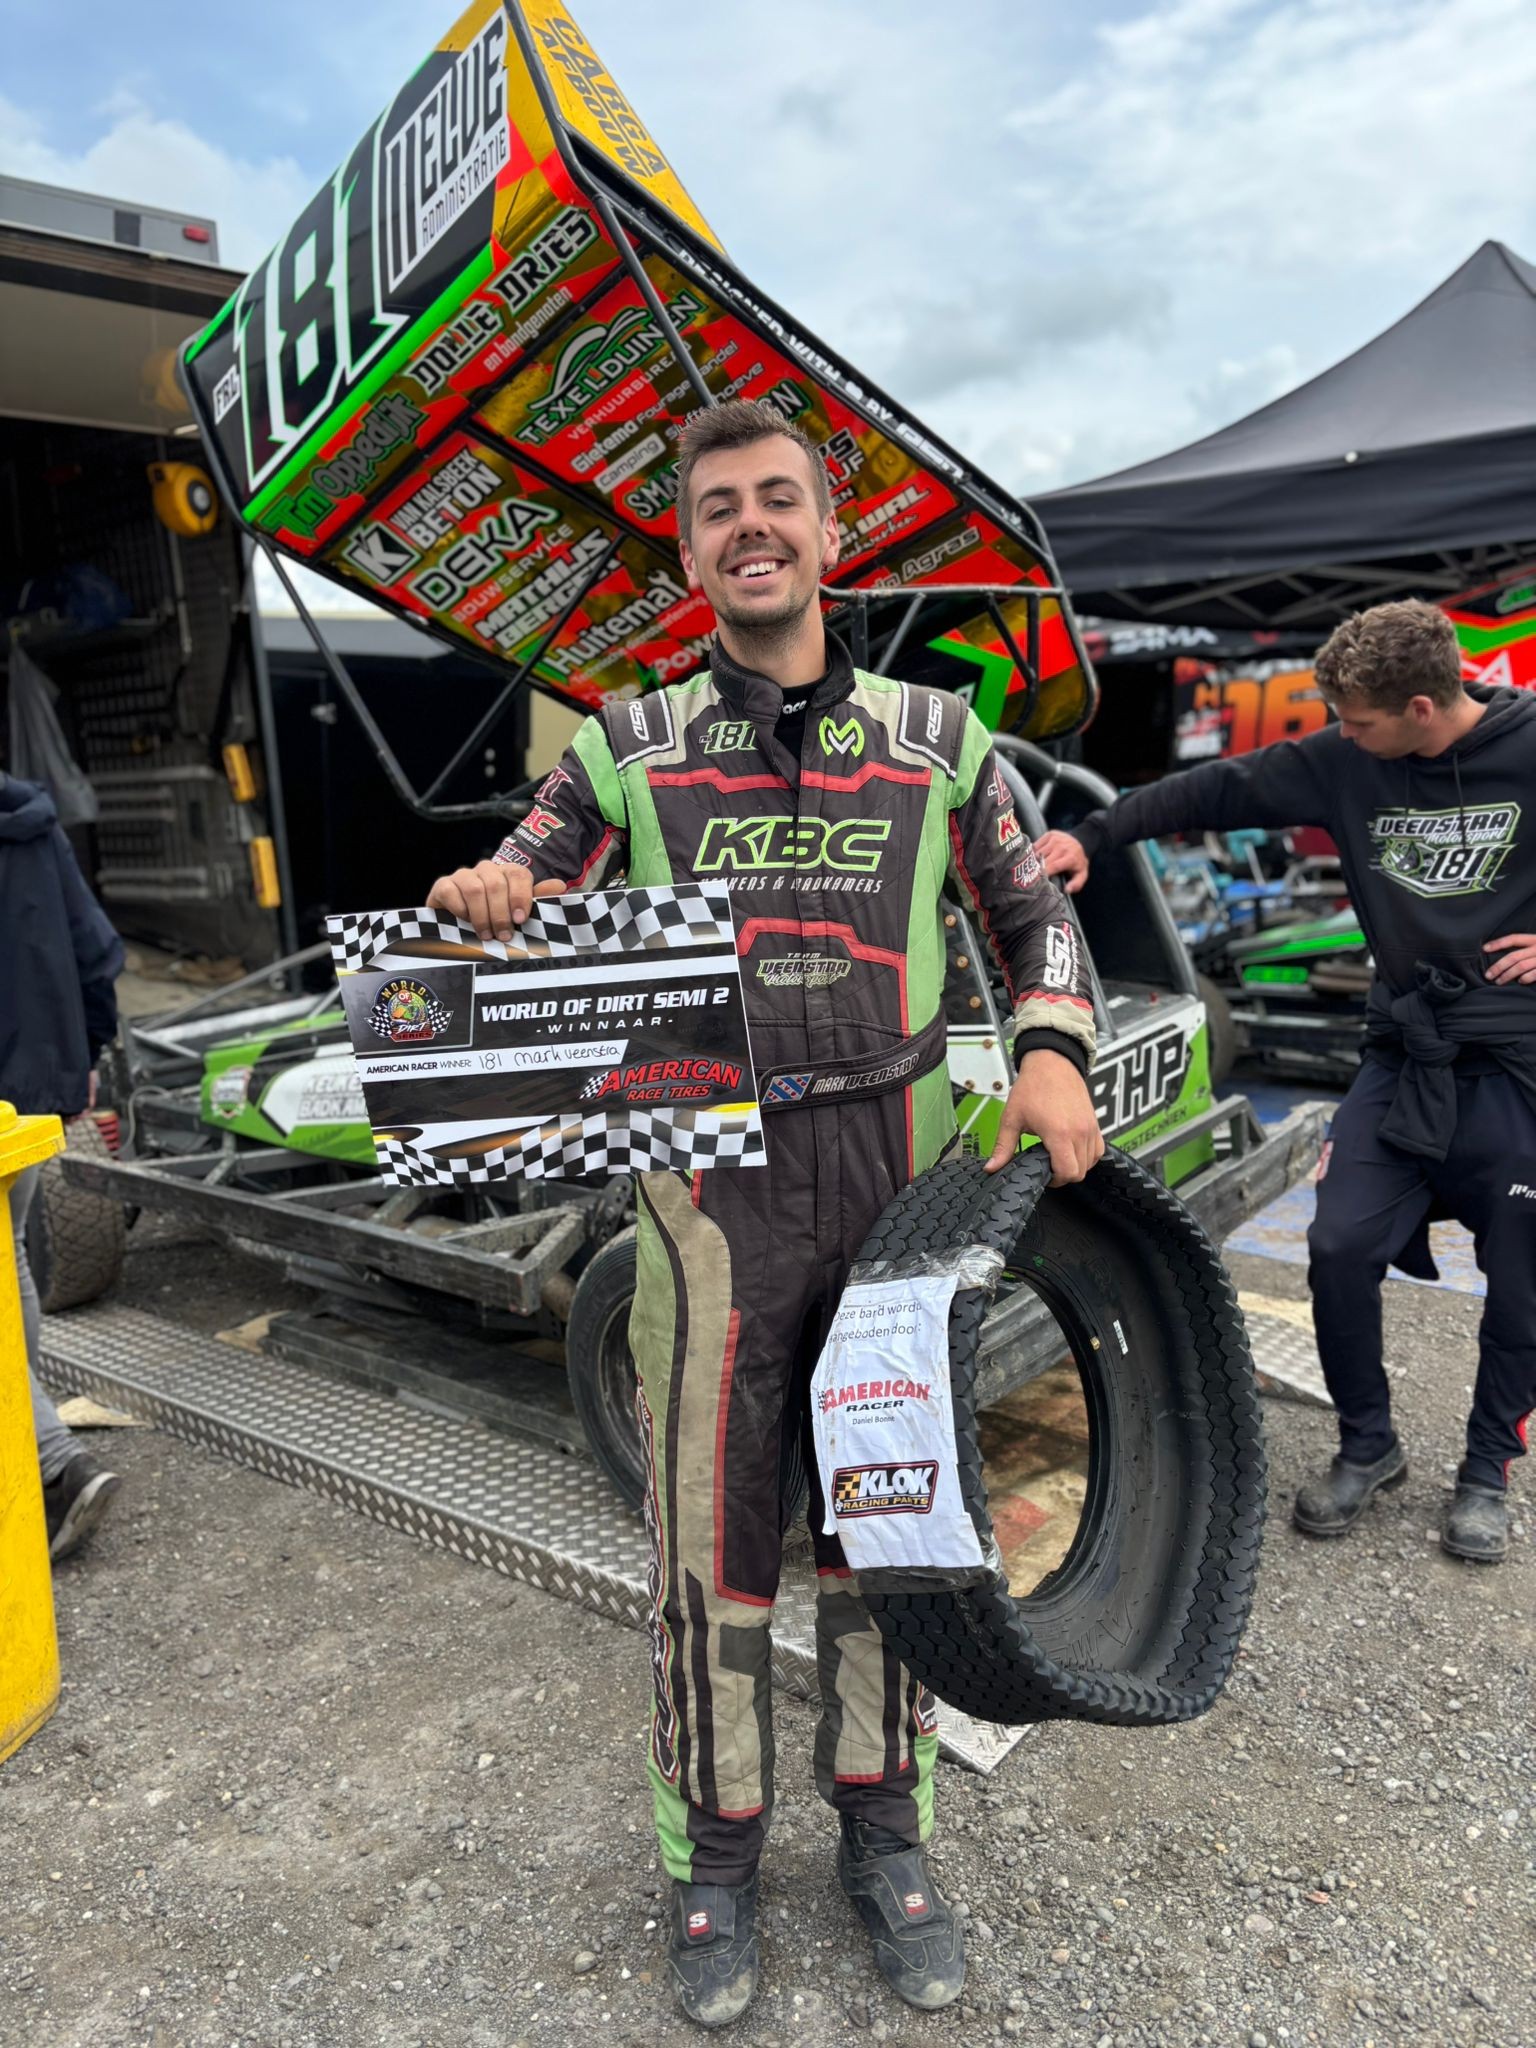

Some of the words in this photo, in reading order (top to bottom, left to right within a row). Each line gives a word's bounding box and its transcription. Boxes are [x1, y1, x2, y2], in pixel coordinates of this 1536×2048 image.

[533, 24, 647, 178] AFBOUW
[552, 16, 667, 175] CARGA
[422, 127, 506, 248] ADMINISTRATIE
[407, 303, 501, 392] DOLLE
[484, 354, 503, 372] en
[500, 286, 573, 359] bondgenoten
[789, 334, 842, 381] WITH
[571, 420, 637, 473] Gietema
[598, 437, 660, 487] Camping
[390, 498, 424, 533] VAN
[415, 450, 479, 513] KALSBEEK
[406, 461, 502, 550] BETON
[411, 499, 556, 610] DEKA
[452, 523, 575, 623] BOUWSERVICE
[475, 528, 612, 639] MATHIJS
[543, 586, 684, 676] Huitema
[1378, 809, 1513, 836] VEENSTRA
[692, 815, 893, 873] KBC
[1424, 847, 1492, 882] 181
[381, 980, 427, 998] WORLD
[399, 993, 410, 1001] OF
[481, 999, 558, 1023] WORLD
[563, 999, 591, 1017] OF
[596, 993, 649, 1014] DIRT
[653, 988, 708, 1010] SEMI
[712, 987, 730, 1006] 2
[396, 1021, 428, 1034] DIRT
[366, 1061, 410, 1075] AMERICAN
[411, 1061, 438, 1073] RACER
[479, 1053, 503, 1071] 181
[598, 1058, 743, 1096] AMERICAN
[626, 1086, 664, 1101] RACE
[668, 1084, 711, 1099] TIRES
[811, 1074, 846, 1094] MARK
[834, 1310, 856, 1321] Deze
[823, 1378, 931, 1415] AMERICAN
[846, 1400, 905, 1412] RACER
[852, 1416, 874, 1425] Daniel
[857, 1466, 935, 1498] KLOK
[843, 1497, 889, 1510] RACING
[893, 1496, 929, 1507] PARTS
